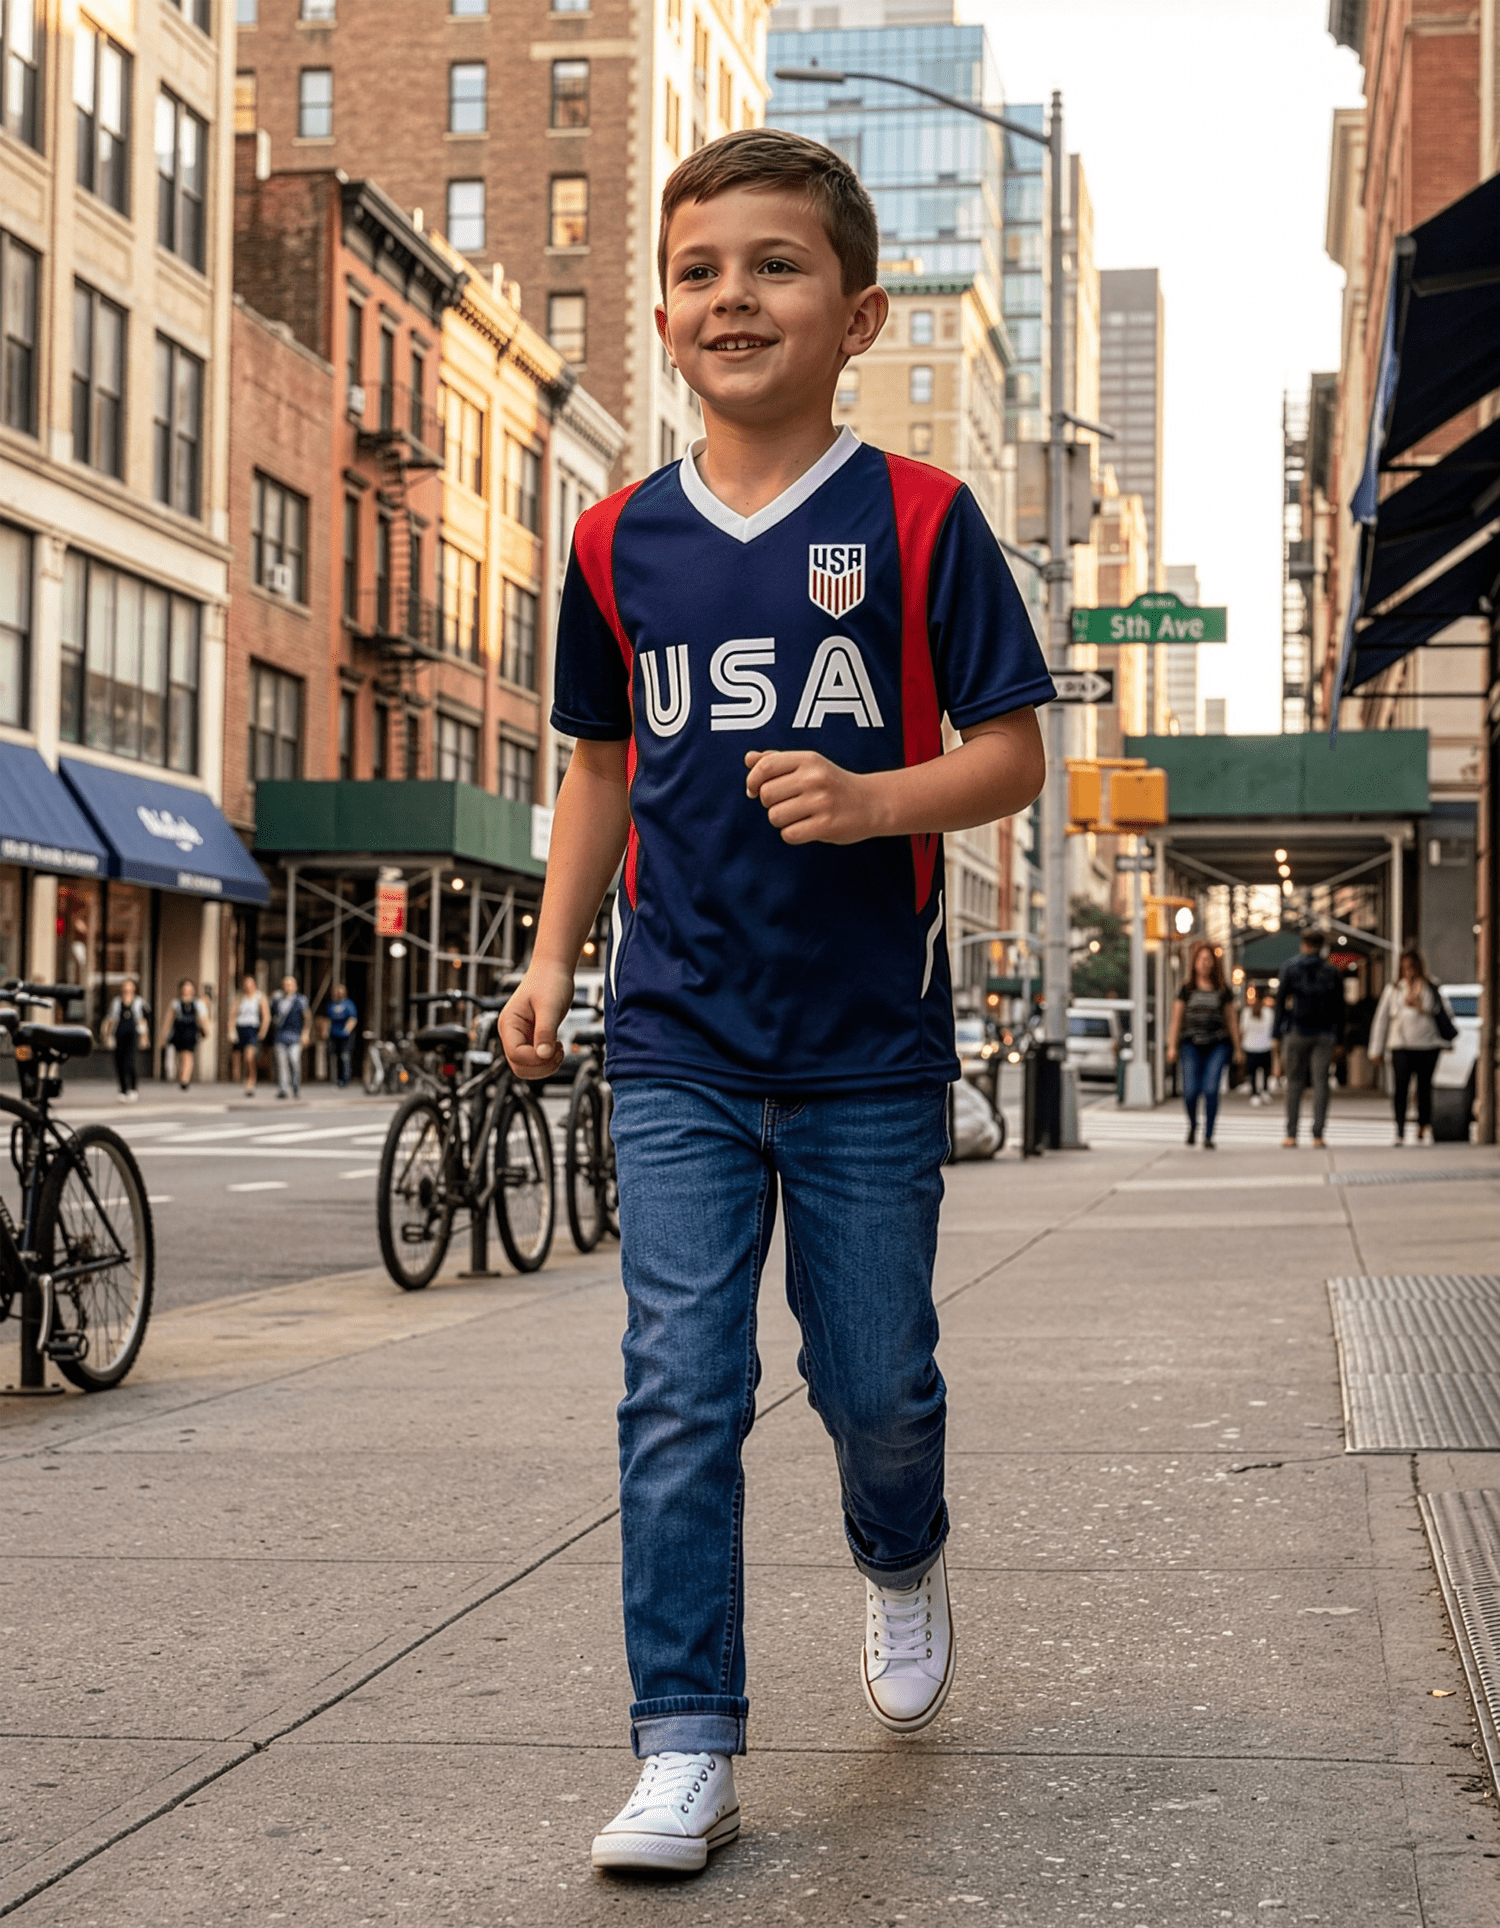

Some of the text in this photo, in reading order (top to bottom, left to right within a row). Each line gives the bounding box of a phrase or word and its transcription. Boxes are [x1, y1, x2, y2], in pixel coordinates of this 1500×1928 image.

[813, 547, 862, 574] USA
[1157, 614, 1204, 639] Ave
[639, 635, 885, 738] USA
